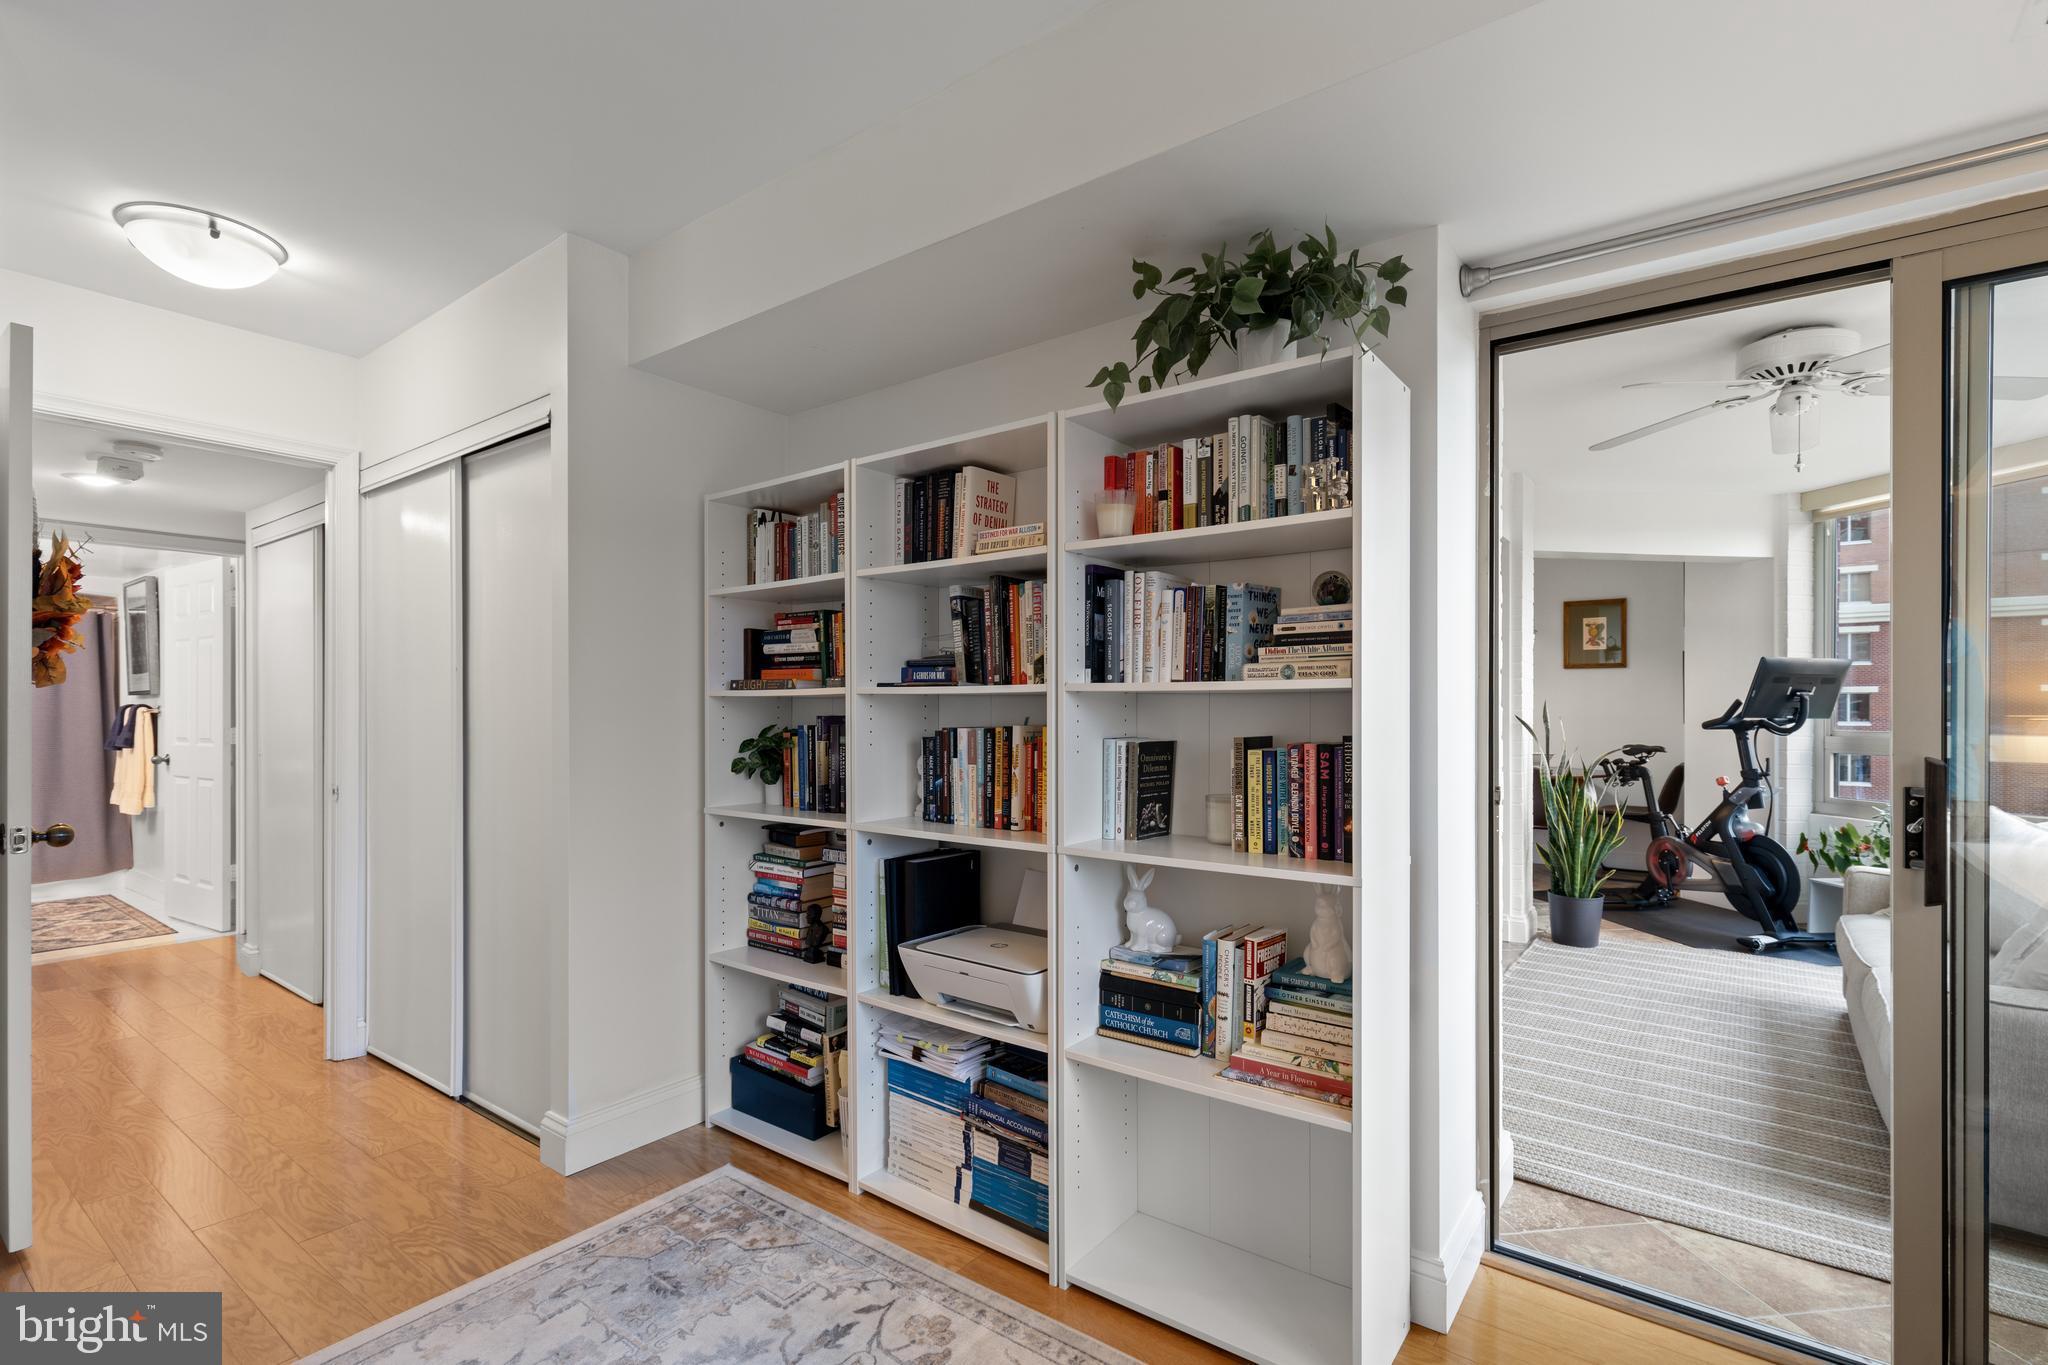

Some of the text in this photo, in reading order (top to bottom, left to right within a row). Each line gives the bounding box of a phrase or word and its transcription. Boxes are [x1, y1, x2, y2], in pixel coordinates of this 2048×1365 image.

[987, 479, 1000, 495] THE
[1147, 481, 1152, 490] Ng
[975, 495, 1009, 515] STRATEGY
[973, 512, 982, 526] OF
[979, 531, 999, 540] DESTINED
[1019, 526, 1037, 534] ALLISON
[1134, 576, 1142, 629] ON FIRE
[1247, 590, 1277, 604] THINGS
[1032, 584, 1041, 625] LIFTOFF
[1256, 607, 1269, 619] WE
[1146, 591, 1154, 662] Atomic Habits
[1264, 647, 1287, 655] Didion
[1321, 644, 1345, 653] Album
[738, 680, 766, 689] FLIGHT
[1140, 753, 1171, 762] Omnivore's
[1344, 741, 1353, 784] RHODES
[1143, 765, 1168, 773] Dilemma
[1319, 752, 1329, 779] SAM
[1290, 749, 1299, 833] UNTAMED GLENNON DOYLE
[1279, 797, 1286, 807] US
[1235, 832, 1242, 841] ME
[756, 907, 779, 920] TITAN
[1281, 976, 1327, 990] THE STARTUP OF YOU
[1281, 992, 1335, 1008] OTHER EINSTEIN
[1104, 1009, 1141, 1023] CATECHISM
[1141, 1016, 1146, 1024] of
[1104, 1019, 1169, 1039] CATHOLIC CHURCH
[766, 1055, 785, 1067] NATIONS
[1259, 1067, 1265, 1075] A
[1266, 1067, 1280, 1078] Year
[1281, 1072, 1289, 1080] in
[1290, 1073, 1318, 1087] Flowers
[979, 1107, 1042, 1139] FINANCIAL ACCOUNTING
